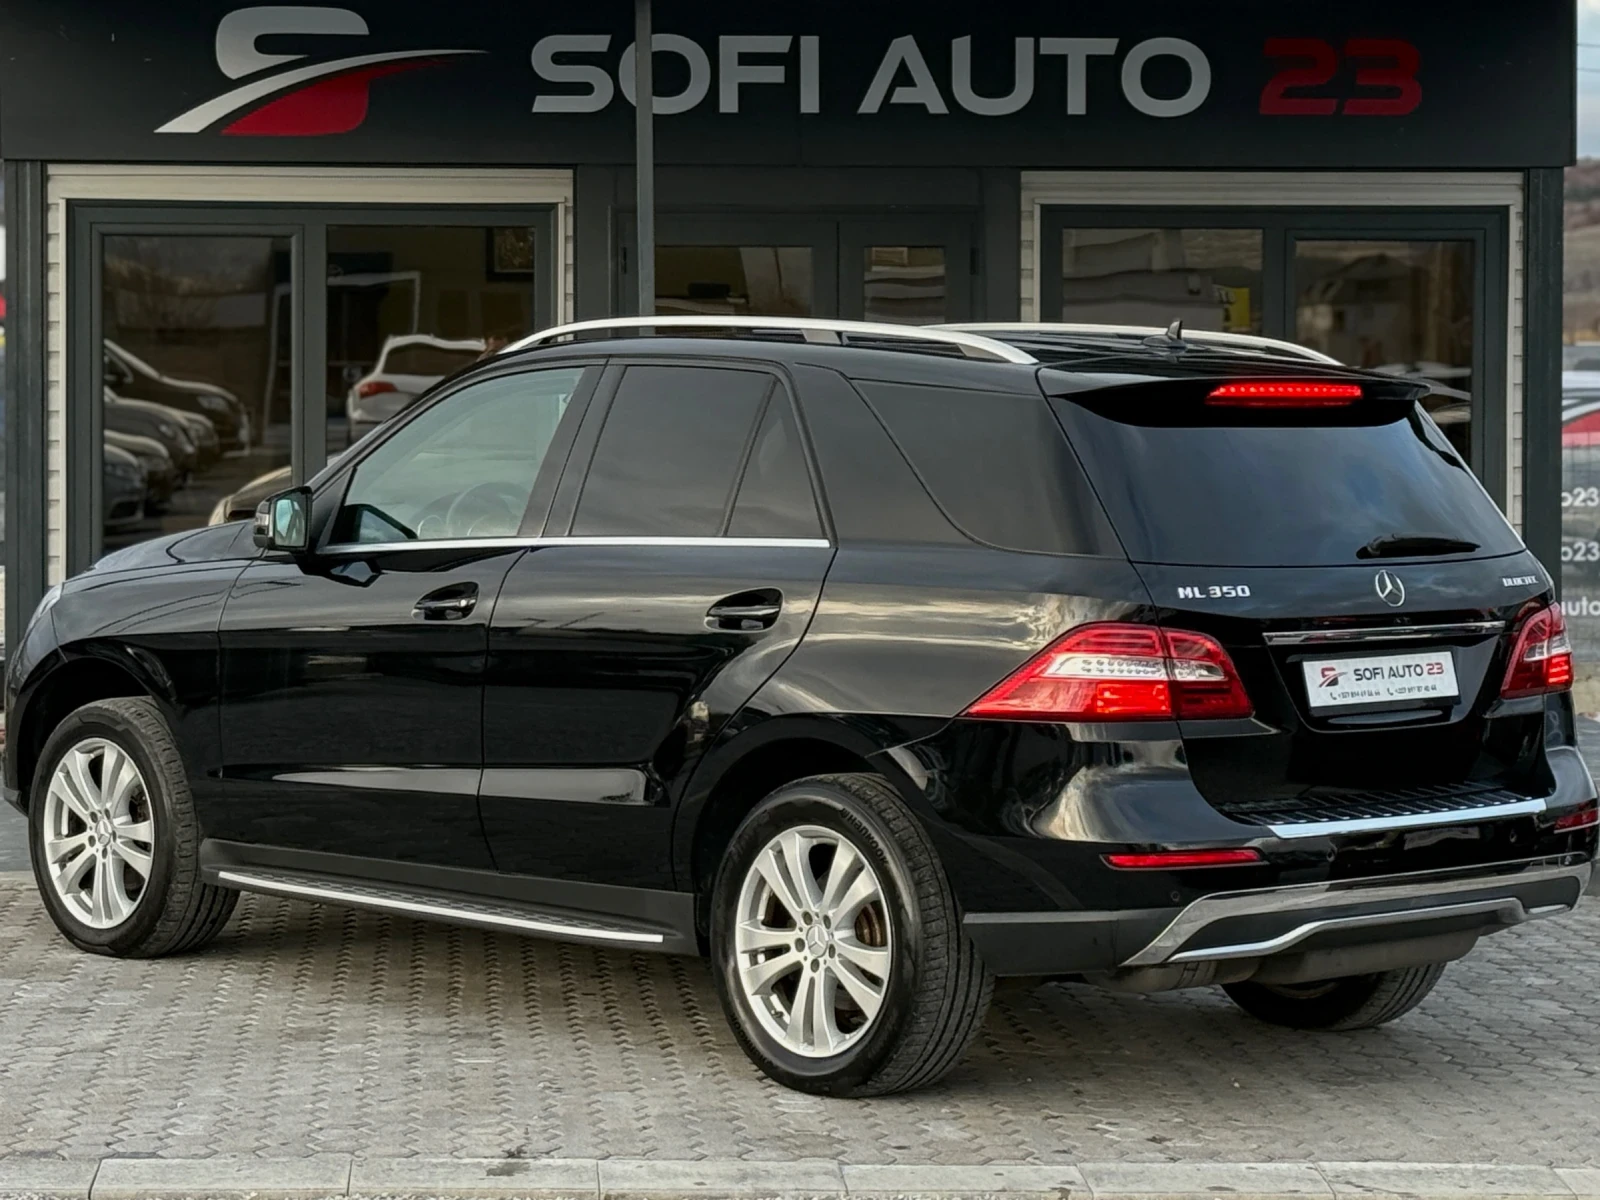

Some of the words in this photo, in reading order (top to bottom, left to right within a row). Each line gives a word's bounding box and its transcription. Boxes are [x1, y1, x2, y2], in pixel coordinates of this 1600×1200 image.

[530, 33, 820, 115] SOFI
[856, 34, 1212, 118] AUTO
[1258, 37, 1424, 116] 23
[1177, 586, 1207, 599] ML
[1207, 584, 1251, 598] 350
[1353, 666, 1385, 681] SOFI
[1387, 663, 1424, 679] AUTO
[1425, 662, 1445, 675] 23
